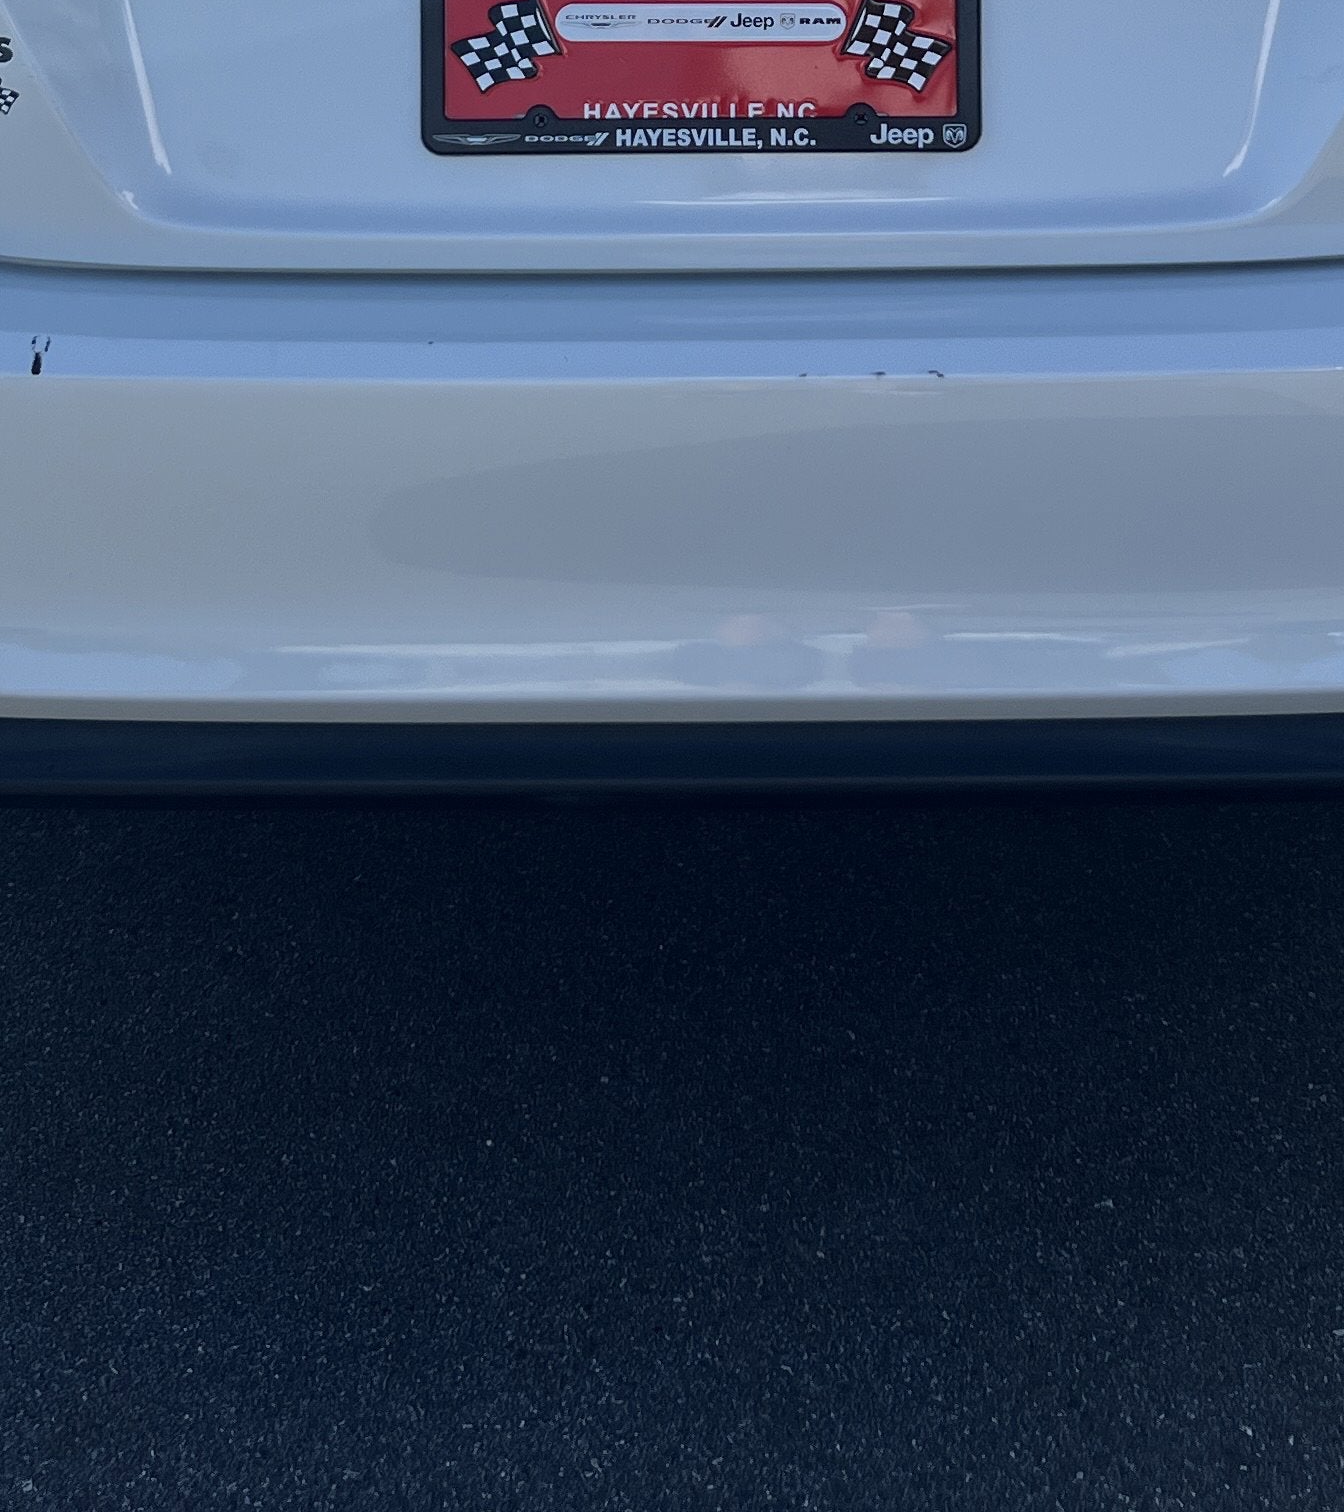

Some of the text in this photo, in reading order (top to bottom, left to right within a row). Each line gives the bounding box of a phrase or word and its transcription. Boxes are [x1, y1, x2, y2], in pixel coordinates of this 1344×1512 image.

[730, 13, 774, 30] Jeep
[799, 17, 842, 25] RAM
[777, 103, 817, 119] NC
[616, 127, 764, 150] HAYESVILLE,
[770, 127, 817, 146] N.C.
[870, 123, 934, 148] Jeep
